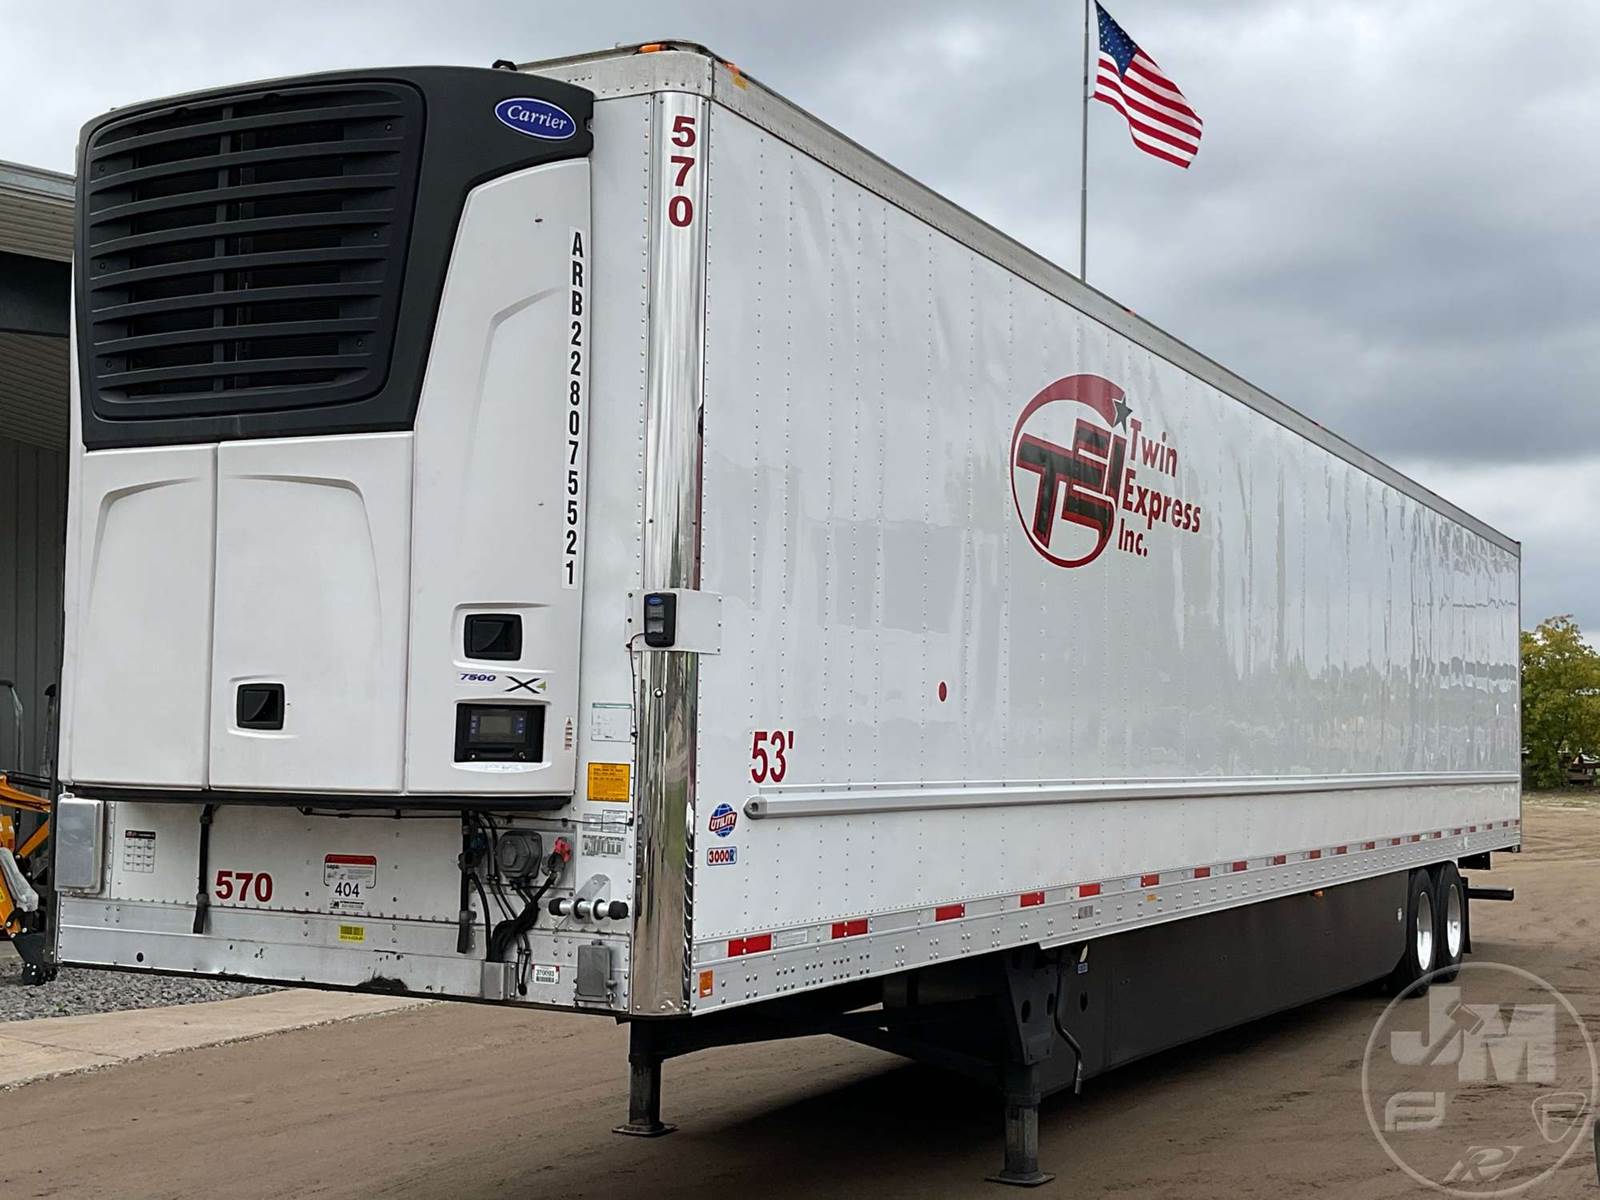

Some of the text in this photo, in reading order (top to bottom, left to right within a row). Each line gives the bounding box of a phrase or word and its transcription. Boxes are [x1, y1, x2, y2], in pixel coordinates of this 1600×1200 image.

[507, 105, 568, 130] Carrier
[668, 115, 696, 227] 570
[565, 231, 584, 585] ARB228075521
[1130, 418, 1178, 478] Twin
[1121, 468, 1201, 534] Express
[1118, 518, 1148, 557] Inc.
[460, 673, 497, 682] 7500
[751, 730, 794, 784] 53'
[710, 813, 737, 831] UTILITY
[708, 849, 735, 864] 3000R
[215, 870, 273, 902] 570
[334, 882, 360, 898] 404
